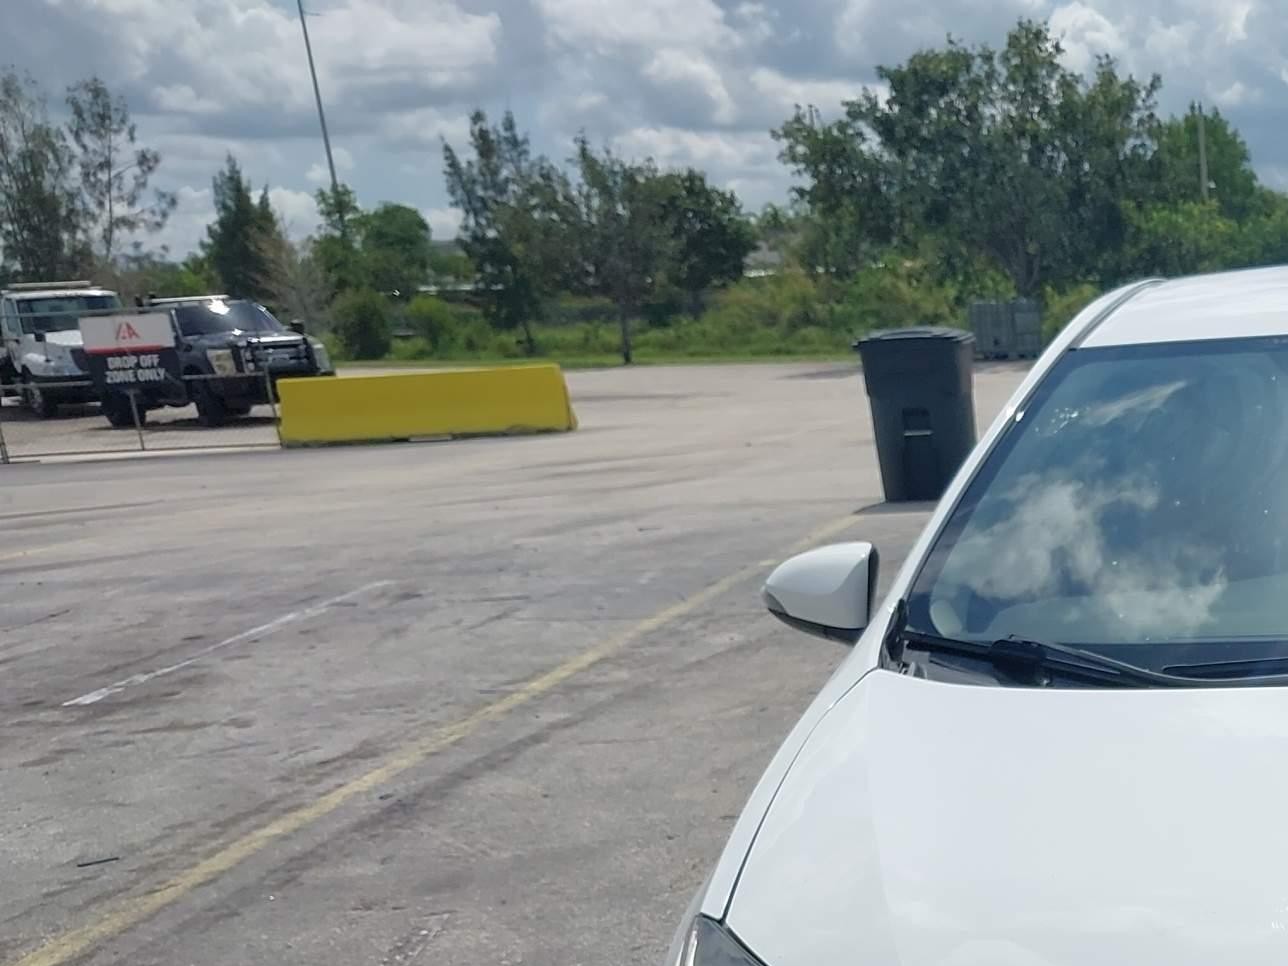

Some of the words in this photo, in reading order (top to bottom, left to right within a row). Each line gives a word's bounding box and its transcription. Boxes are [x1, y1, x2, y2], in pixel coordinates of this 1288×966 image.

[106, 355, 138, 370] DROP
[139, 353, 160, 369] OFF
[105, 370, 137, 384] ZONE
[137, 367, 166, 382] ONLY
